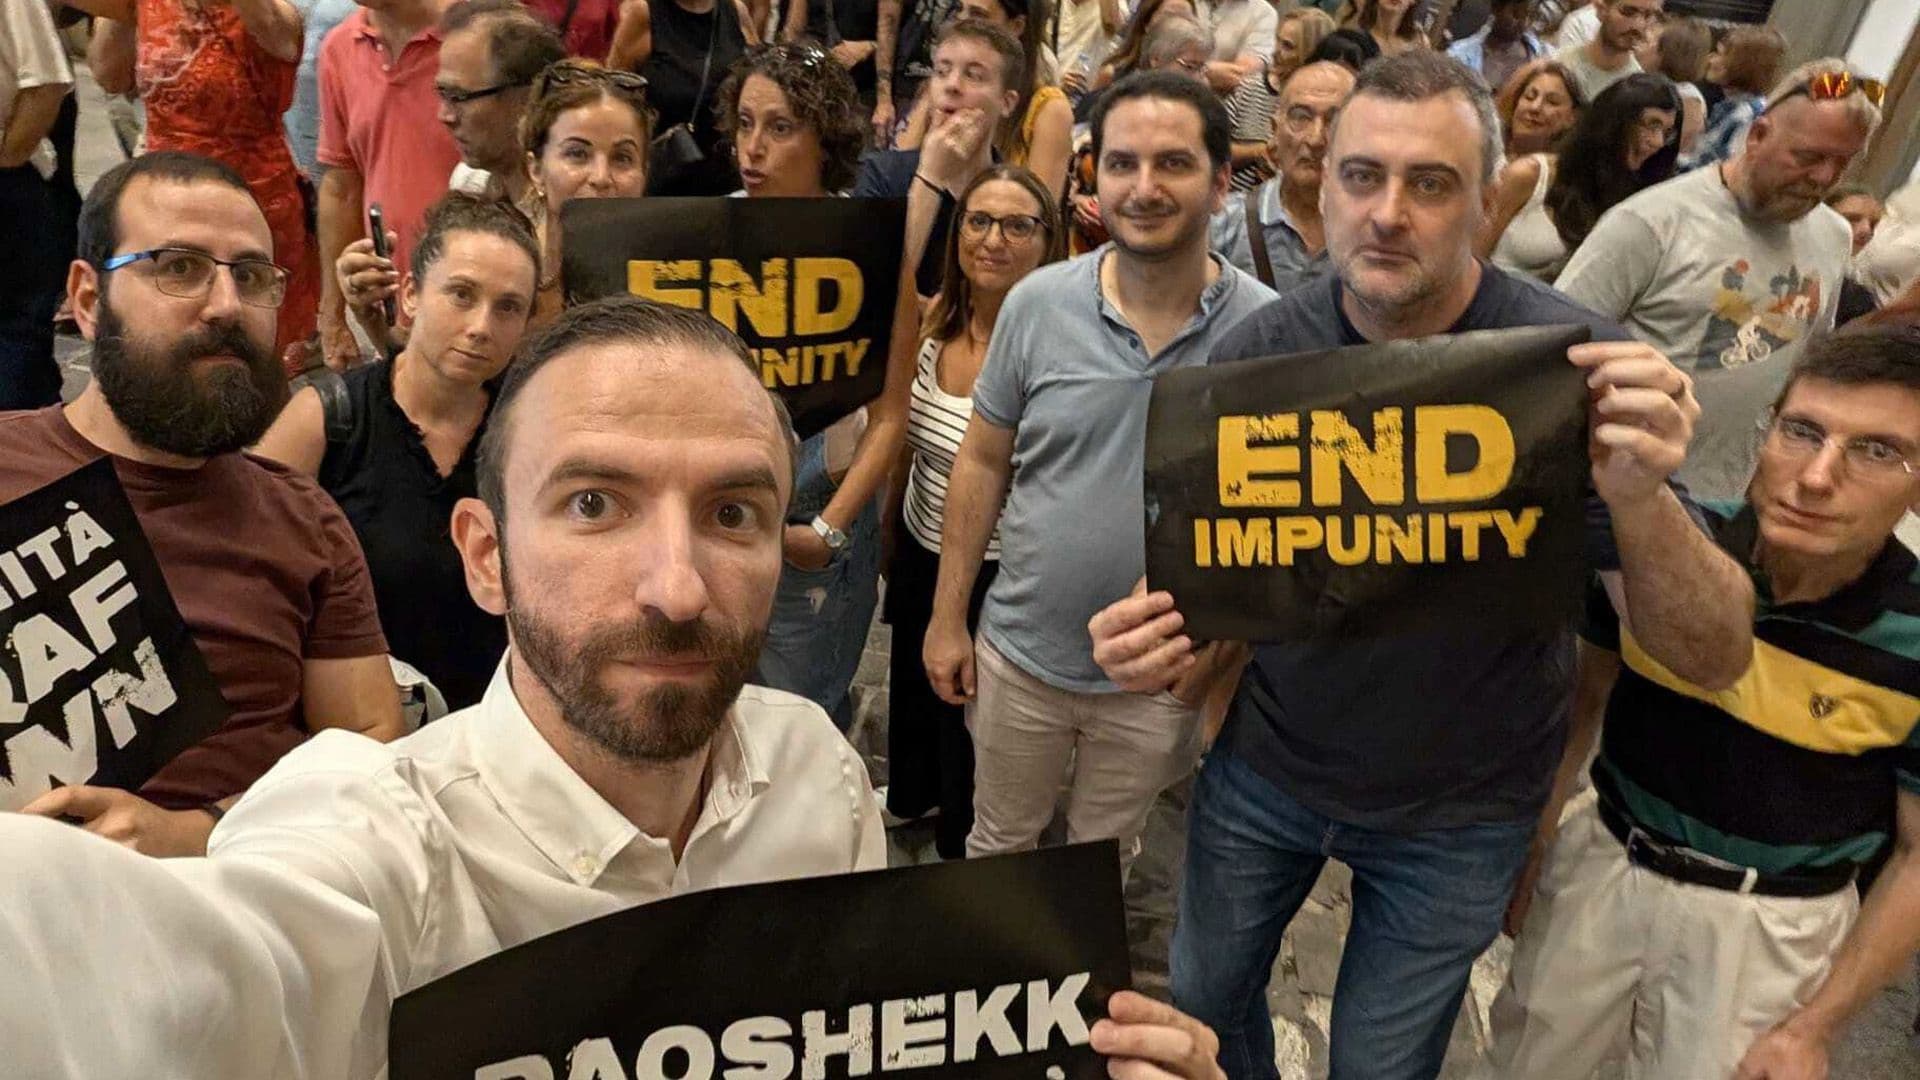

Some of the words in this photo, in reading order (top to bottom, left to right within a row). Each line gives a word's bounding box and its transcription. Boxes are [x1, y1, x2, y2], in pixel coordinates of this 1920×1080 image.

[750, 338, 871, 389] NITY
[1217, 403, 1517, 508] END
[1194, 506, 1543, 568] IMPUNITY
